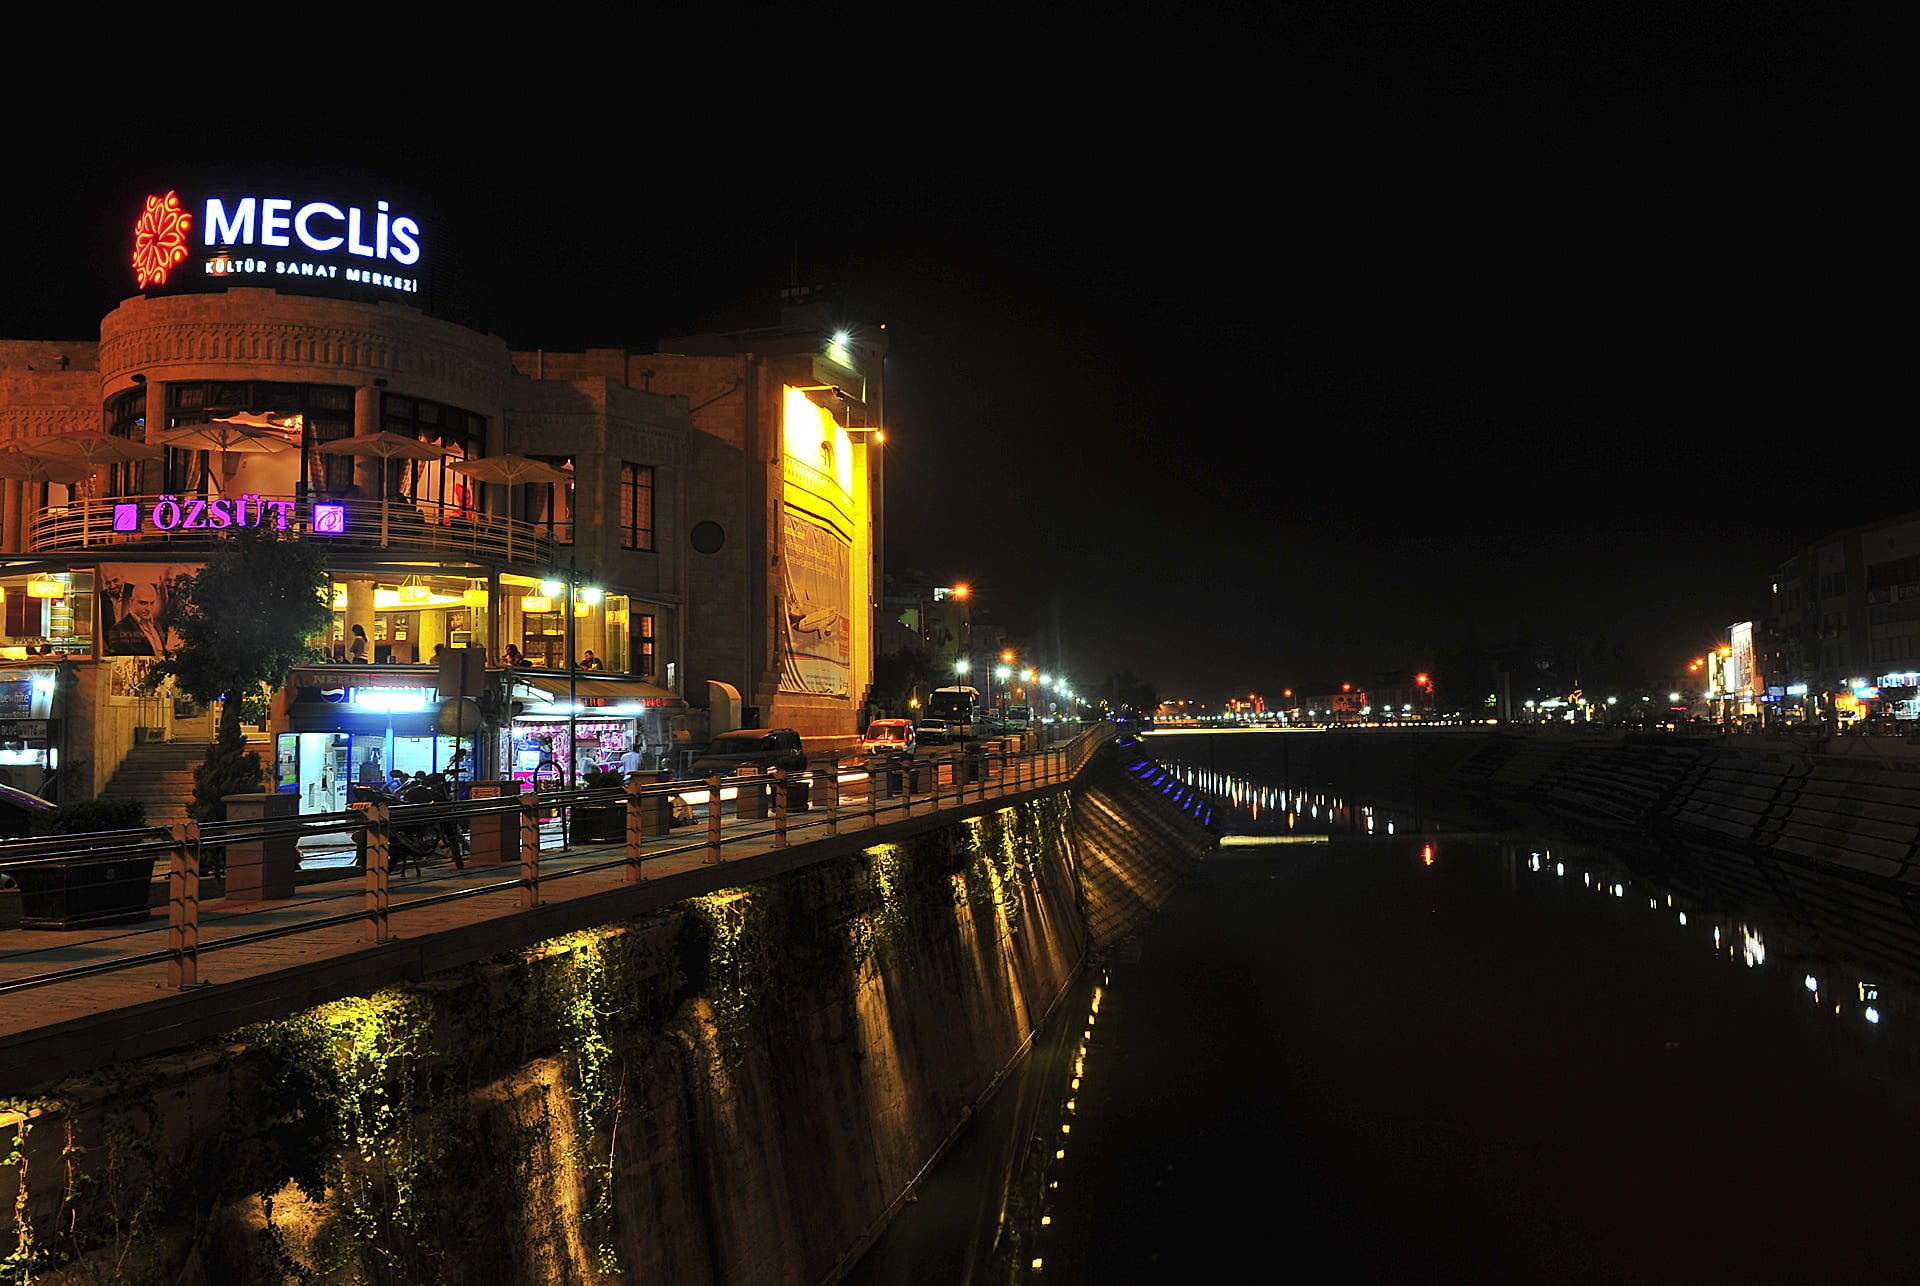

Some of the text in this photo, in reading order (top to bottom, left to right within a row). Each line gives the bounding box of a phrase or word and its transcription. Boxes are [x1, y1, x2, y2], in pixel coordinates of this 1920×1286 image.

[204, 198, 420, 265] MECLİS
[205, 258, 267, 273] KÜLTÜR
[276, 261, 337, 278] SANAT
[152, 494, 296, 530] ÖZSÜT
